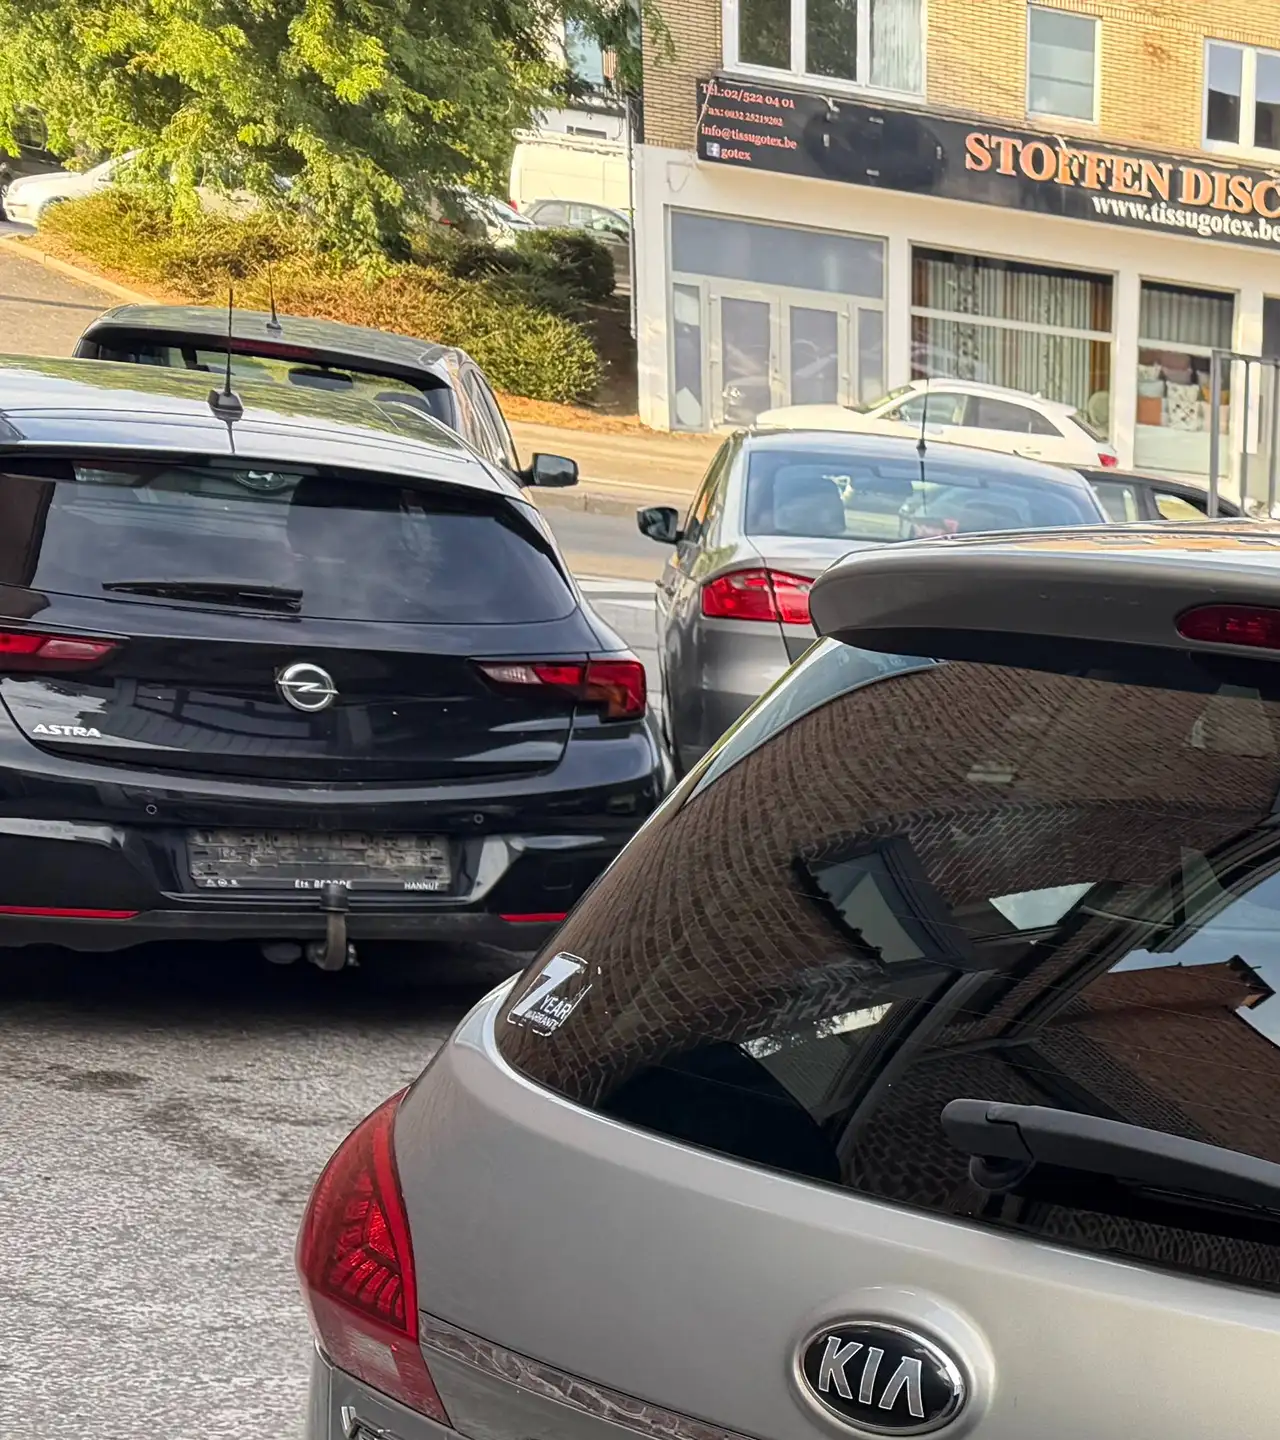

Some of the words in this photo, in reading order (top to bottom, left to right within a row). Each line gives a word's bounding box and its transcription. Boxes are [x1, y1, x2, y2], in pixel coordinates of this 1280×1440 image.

[765, 96, 779, 108] 04
[781, 98, 796, 110] 01
[701, 123, 798, 149] info@tissugotex.be
[721, 146, 752, 161] gotex
[965, 132, 1173, 201] STOFFEN
[32, 723, 102, 738] ASTRA
[540, 994, 573, 1020] YEAR
[818, 1335, 925, 1418] KIA
